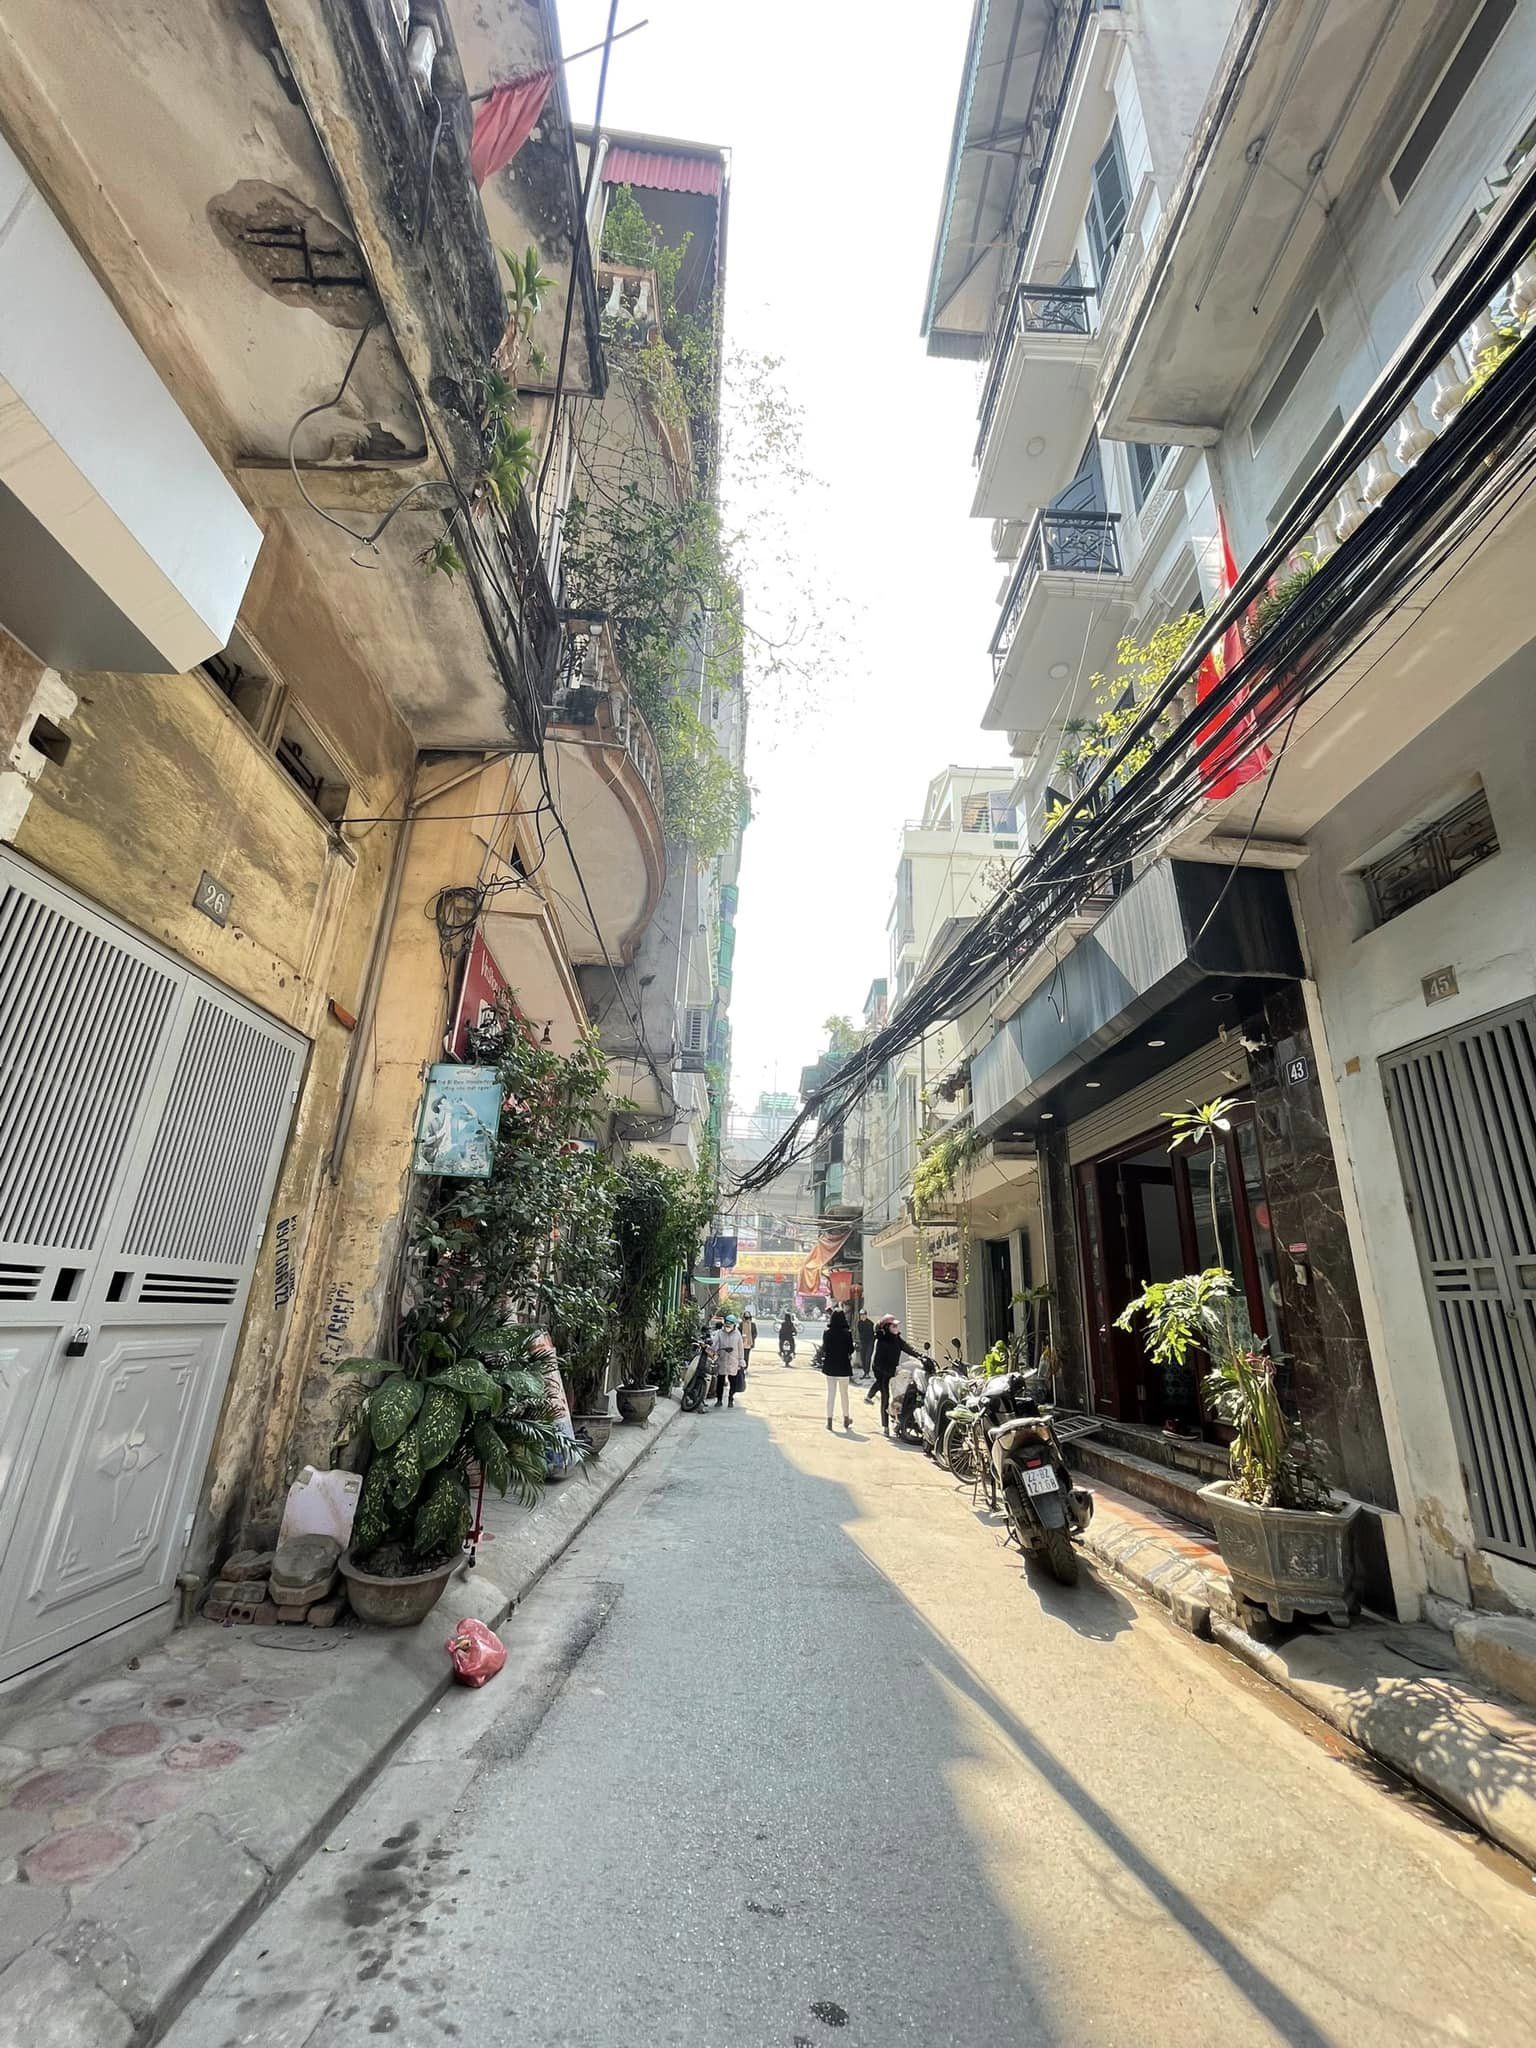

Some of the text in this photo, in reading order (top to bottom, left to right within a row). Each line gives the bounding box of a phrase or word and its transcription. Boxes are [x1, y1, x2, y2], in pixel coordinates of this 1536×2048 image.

[204, 885, 225, 914] 26
[1430, 975, 1450, 997] 45
[1290, 1062, 1304, 1080] 43
